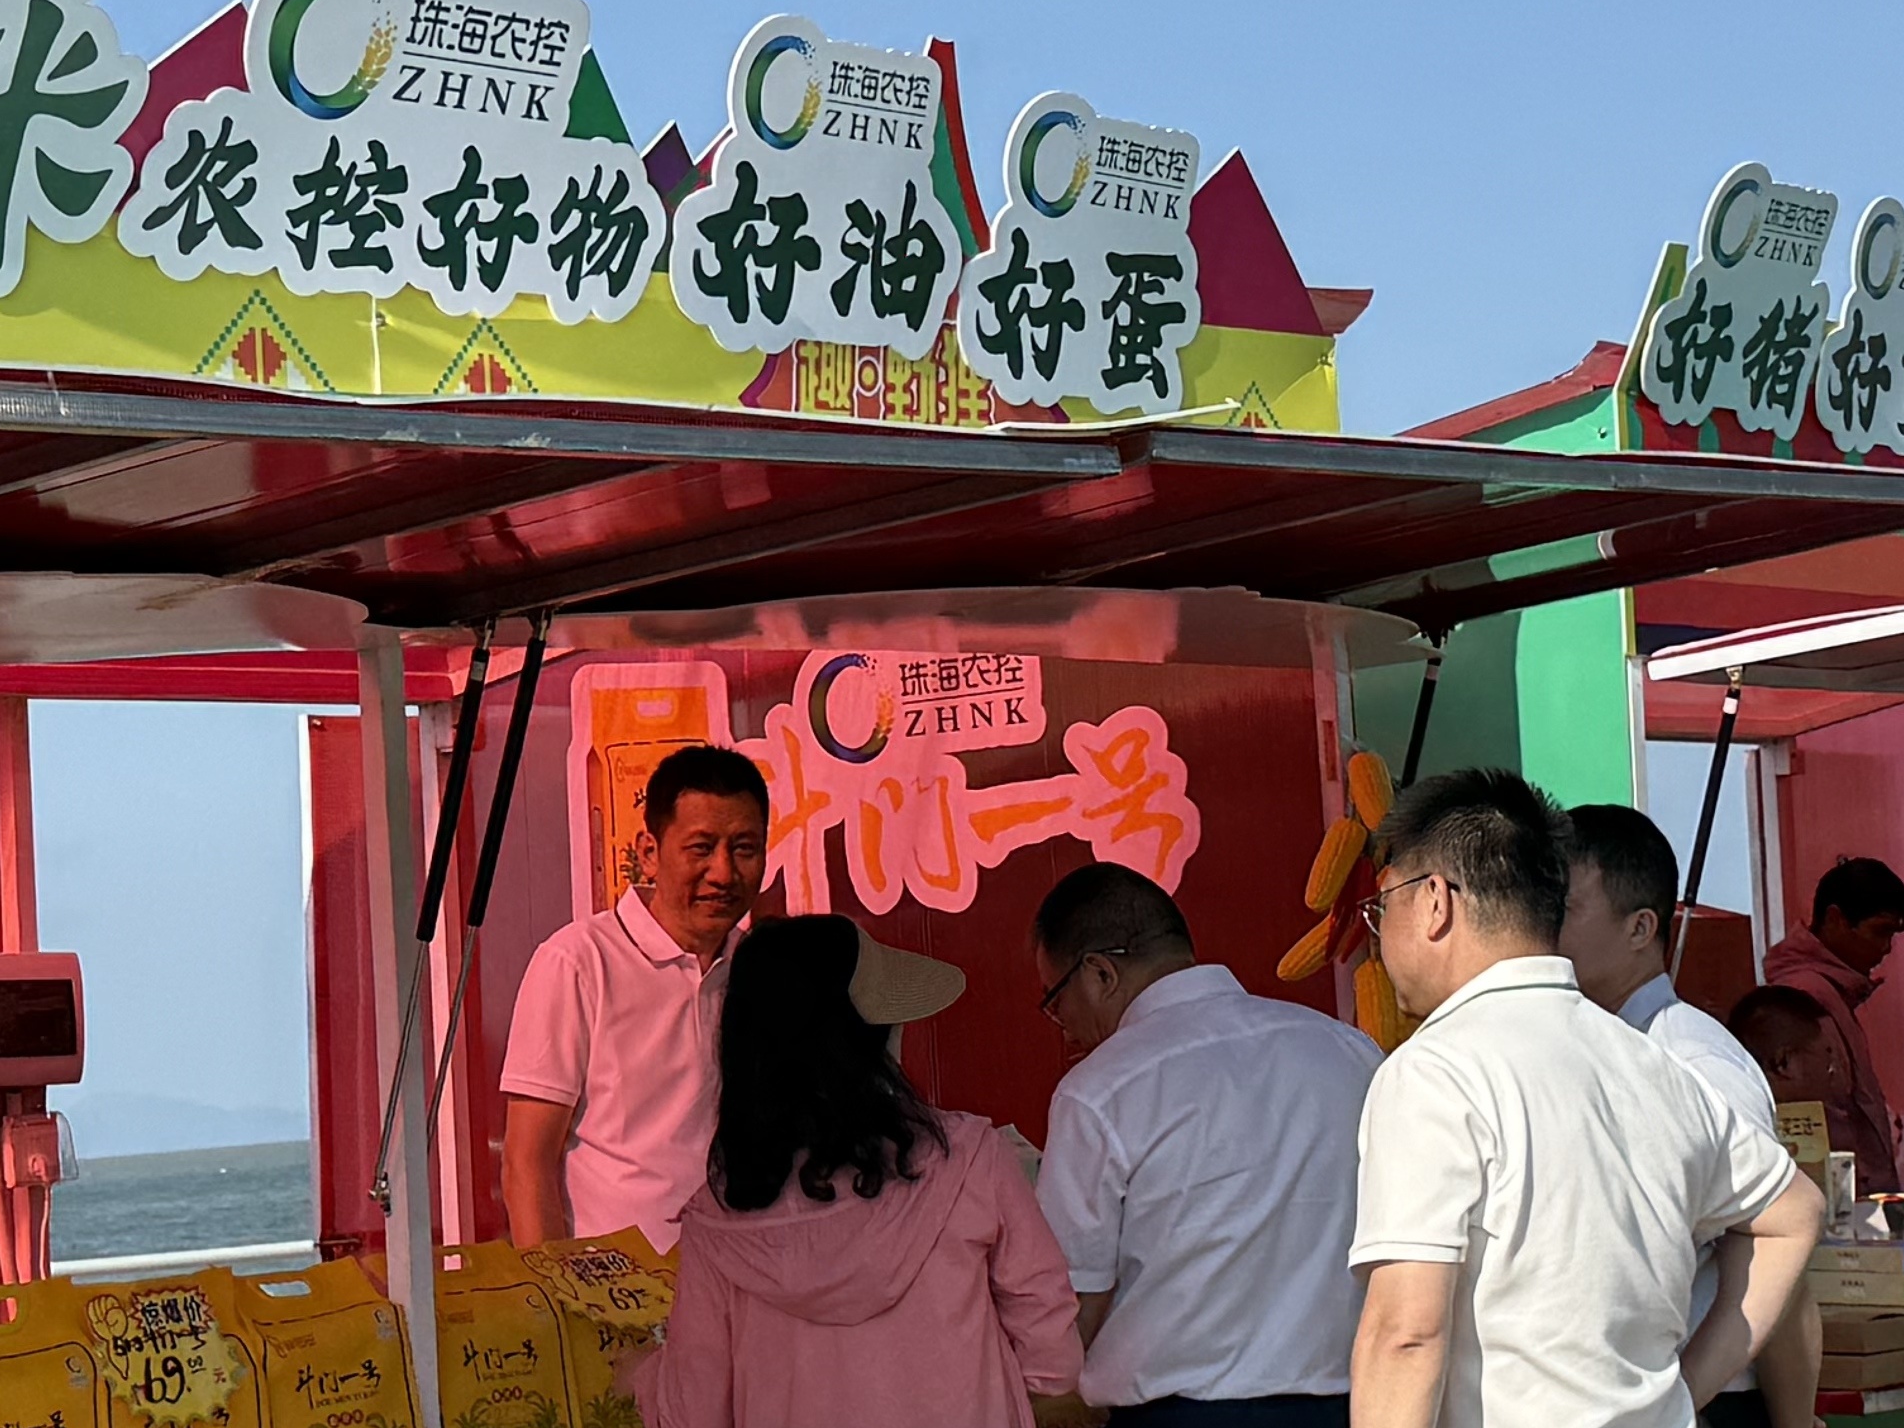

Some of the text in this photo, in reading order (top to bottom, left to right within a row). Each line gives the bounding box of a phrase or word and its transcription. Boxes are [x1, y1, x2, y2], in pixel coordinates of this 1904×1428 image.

[392, 64, 555, 122] ZHNK
[827, 60, 931, 111] 珠海农控
[822, 109, 923, 150] ZHNK
[1095, 136, 1189, 182] 珠海农控
[142, 116, 649, 302] 农控好物
[1090, 181, 1181, 219] ZHNK
[693, 162, 944, 332] 好油
[1753, 236, 1820, 267] ZHNK
[975, 227, 1185, 399] 好蛋
[1656, 278, 1820, 419] 好猪
[899, 653, 1024, 696] 珠海农控
[904, 697, 1028, 737] ZHNK
[295, 1359, 381, 1410] 斗门一号
[463, 1339, 538, 1382] 斗门一号
